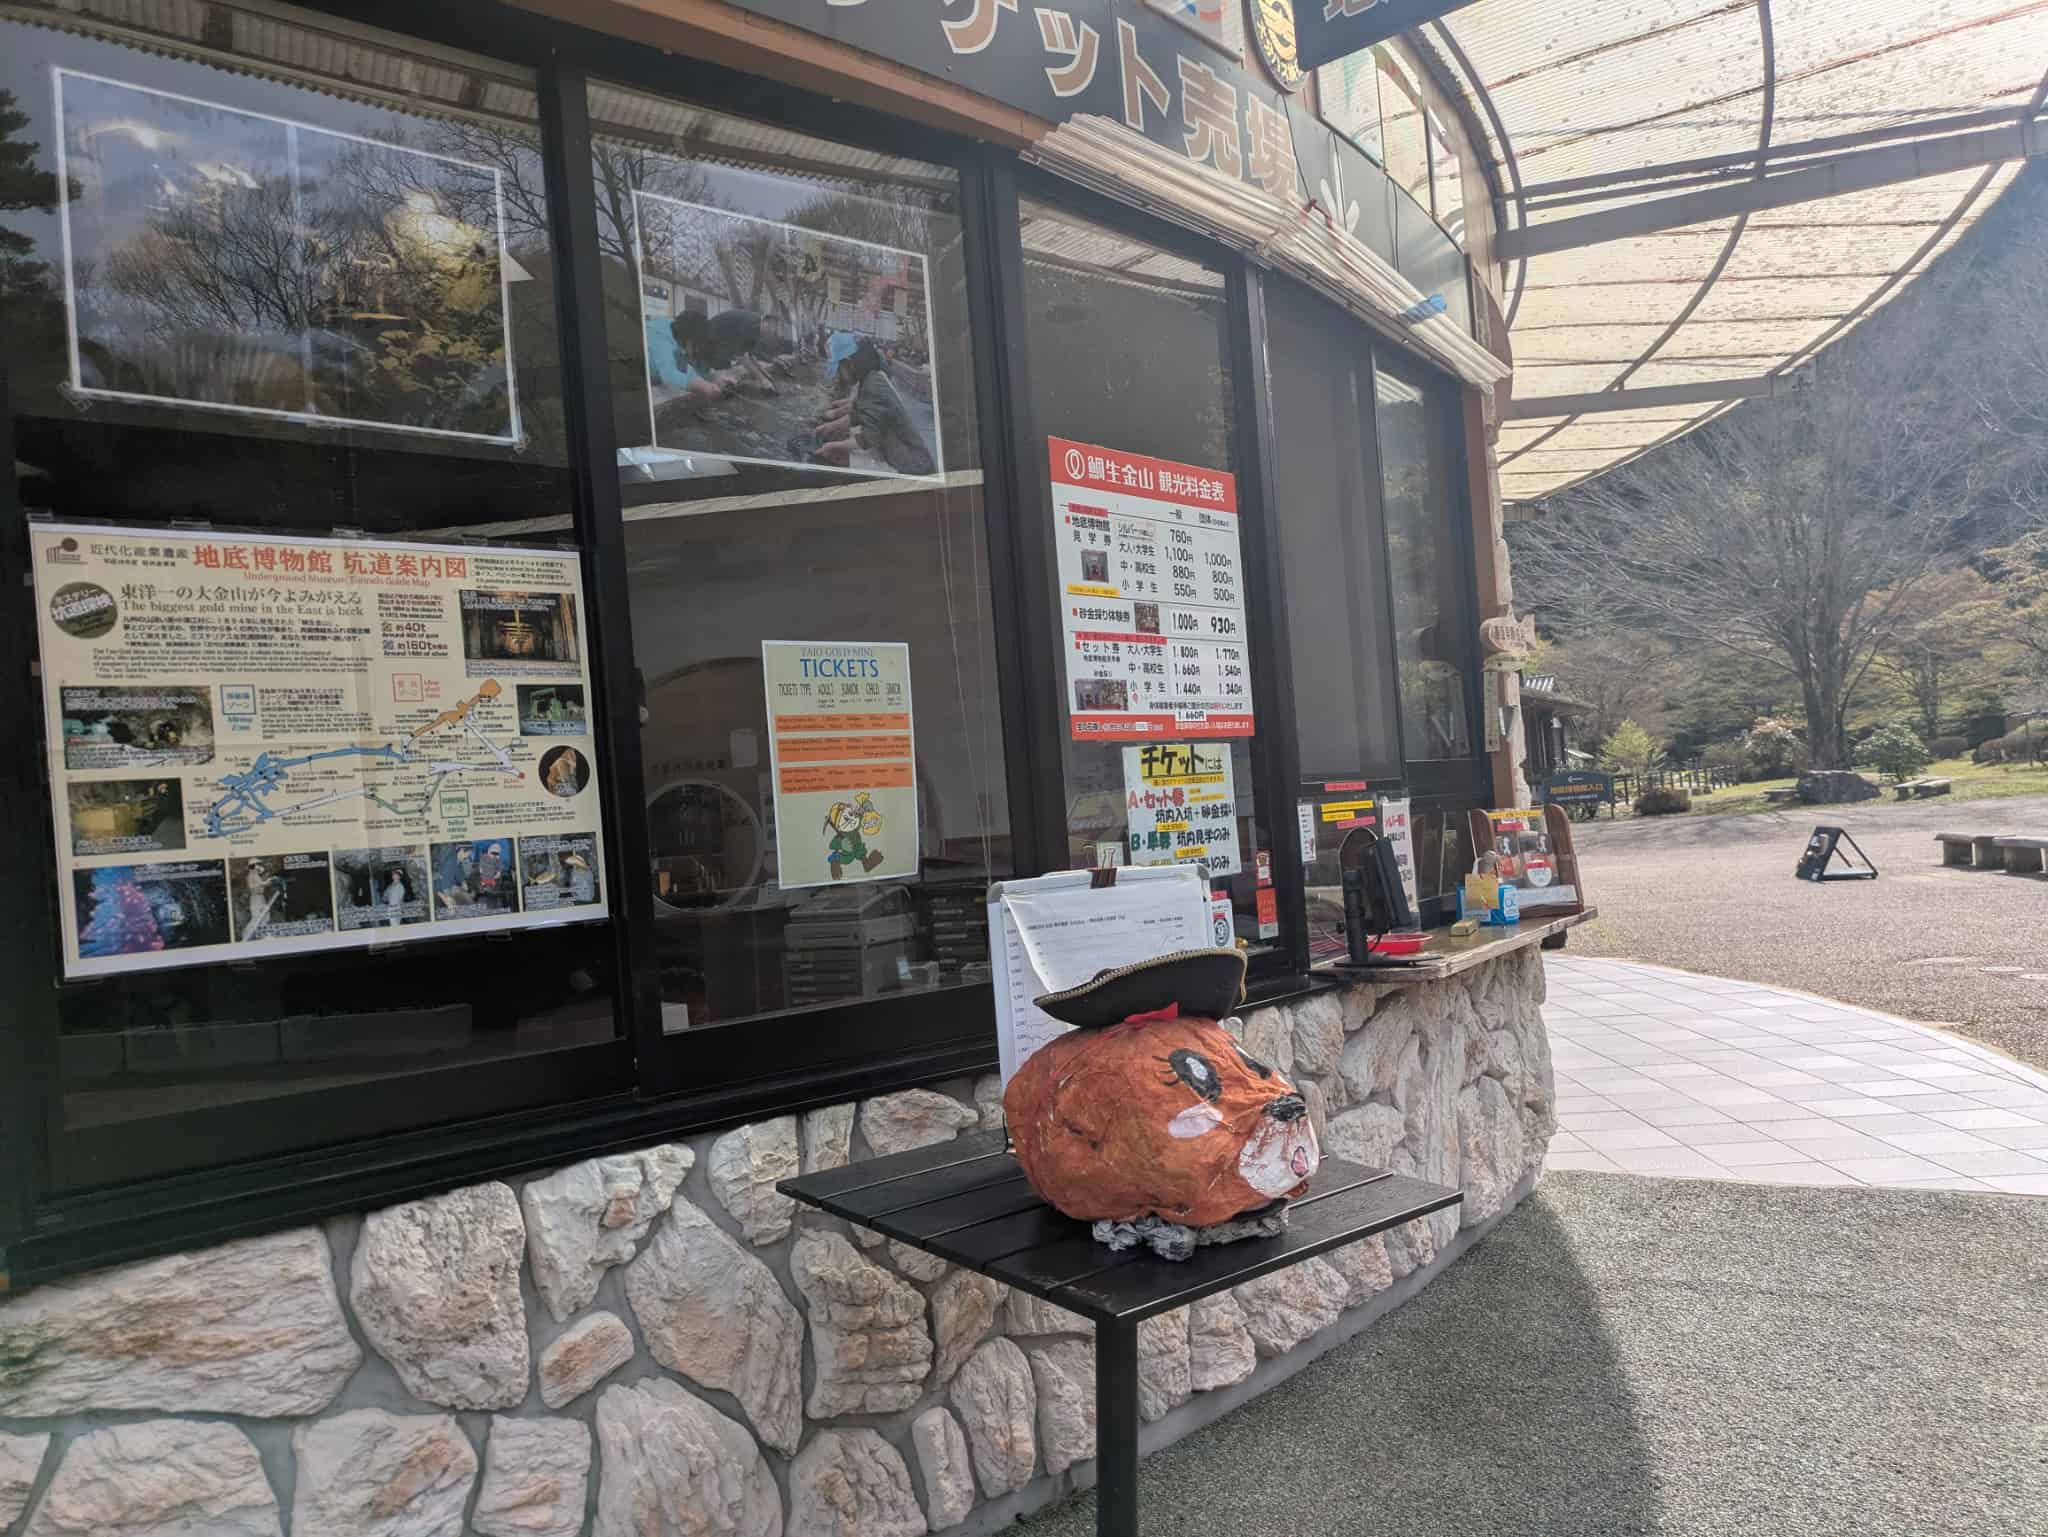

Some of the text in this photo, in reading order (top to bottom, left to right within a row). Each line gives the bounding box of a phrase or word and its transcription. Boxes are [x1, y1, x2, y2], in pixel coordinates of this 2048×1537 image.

[826, 0, 1298, 203] ット売場
[1087, 455, 1225, 503] 鯛生金山 観光料金表
[1071, 516, 1110, 532] 地底博物館
[1169, 529, 1192, 545] 760円
[192, 544, 332, 574] 地底博物館
[343, 551, 468, 579] 坑道案内図
[1164, 546, 1194, 562] 1,100円
[1204, 552, 1232, 568] 1,000円
[1172, 565, 1195, 580] 880円
[1212, 570, 1233, 585] 800円
[121, 584, 361, 605] 東洋一の大金山が今よみがえる
[1174, 583, 1197, 600] 550円
[1213, 588, 1235, 603] 500円
[121, 599, 144, 611] The
[150, 600, 193, 613] biggest
[199, 602, 225, 614] gold
[229, 603, 257, 613] mine
[262, 603, 272, 614] in
[276, 603, 293, 614] the
[297, 605, 320, 615] East
[1210, 616, 1236, 634] 930円
[799, 658, 880, 677] TICKETS
[1141, 744, 1223, 777] チケットには
